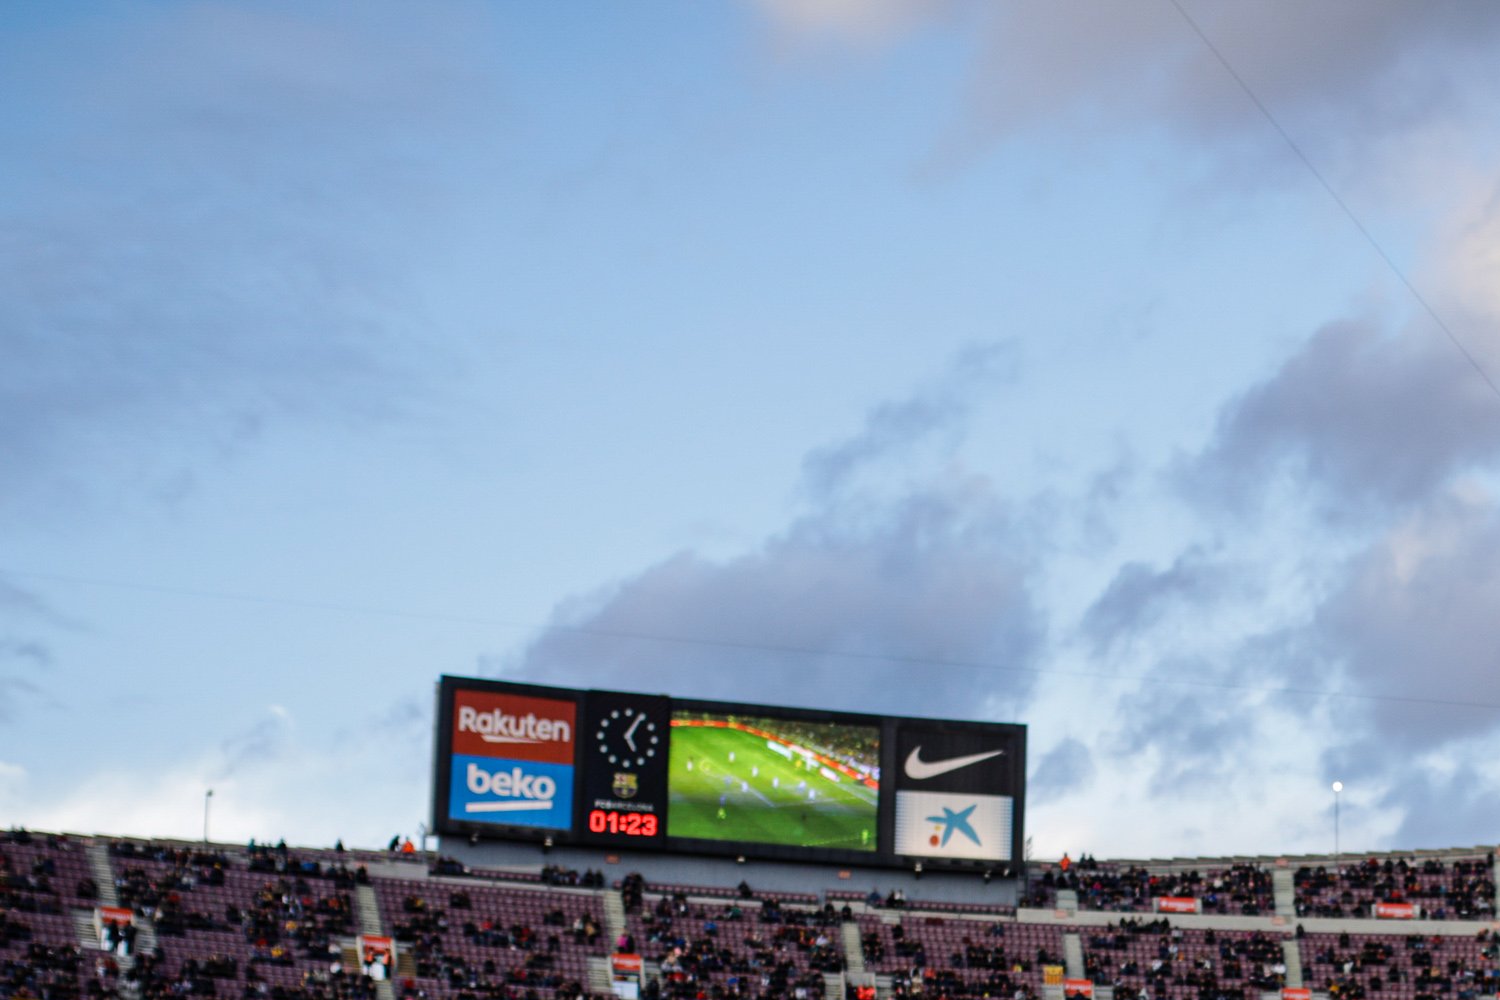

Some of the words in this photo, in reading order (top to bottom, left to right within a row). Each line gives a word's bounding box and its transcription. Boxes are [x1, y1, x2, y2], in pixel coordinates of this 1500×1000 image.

[459, 706, 570, 742] Rakuten
[467, 763, 555, 799] beko
[589, 809, 658, 836] 01:23
